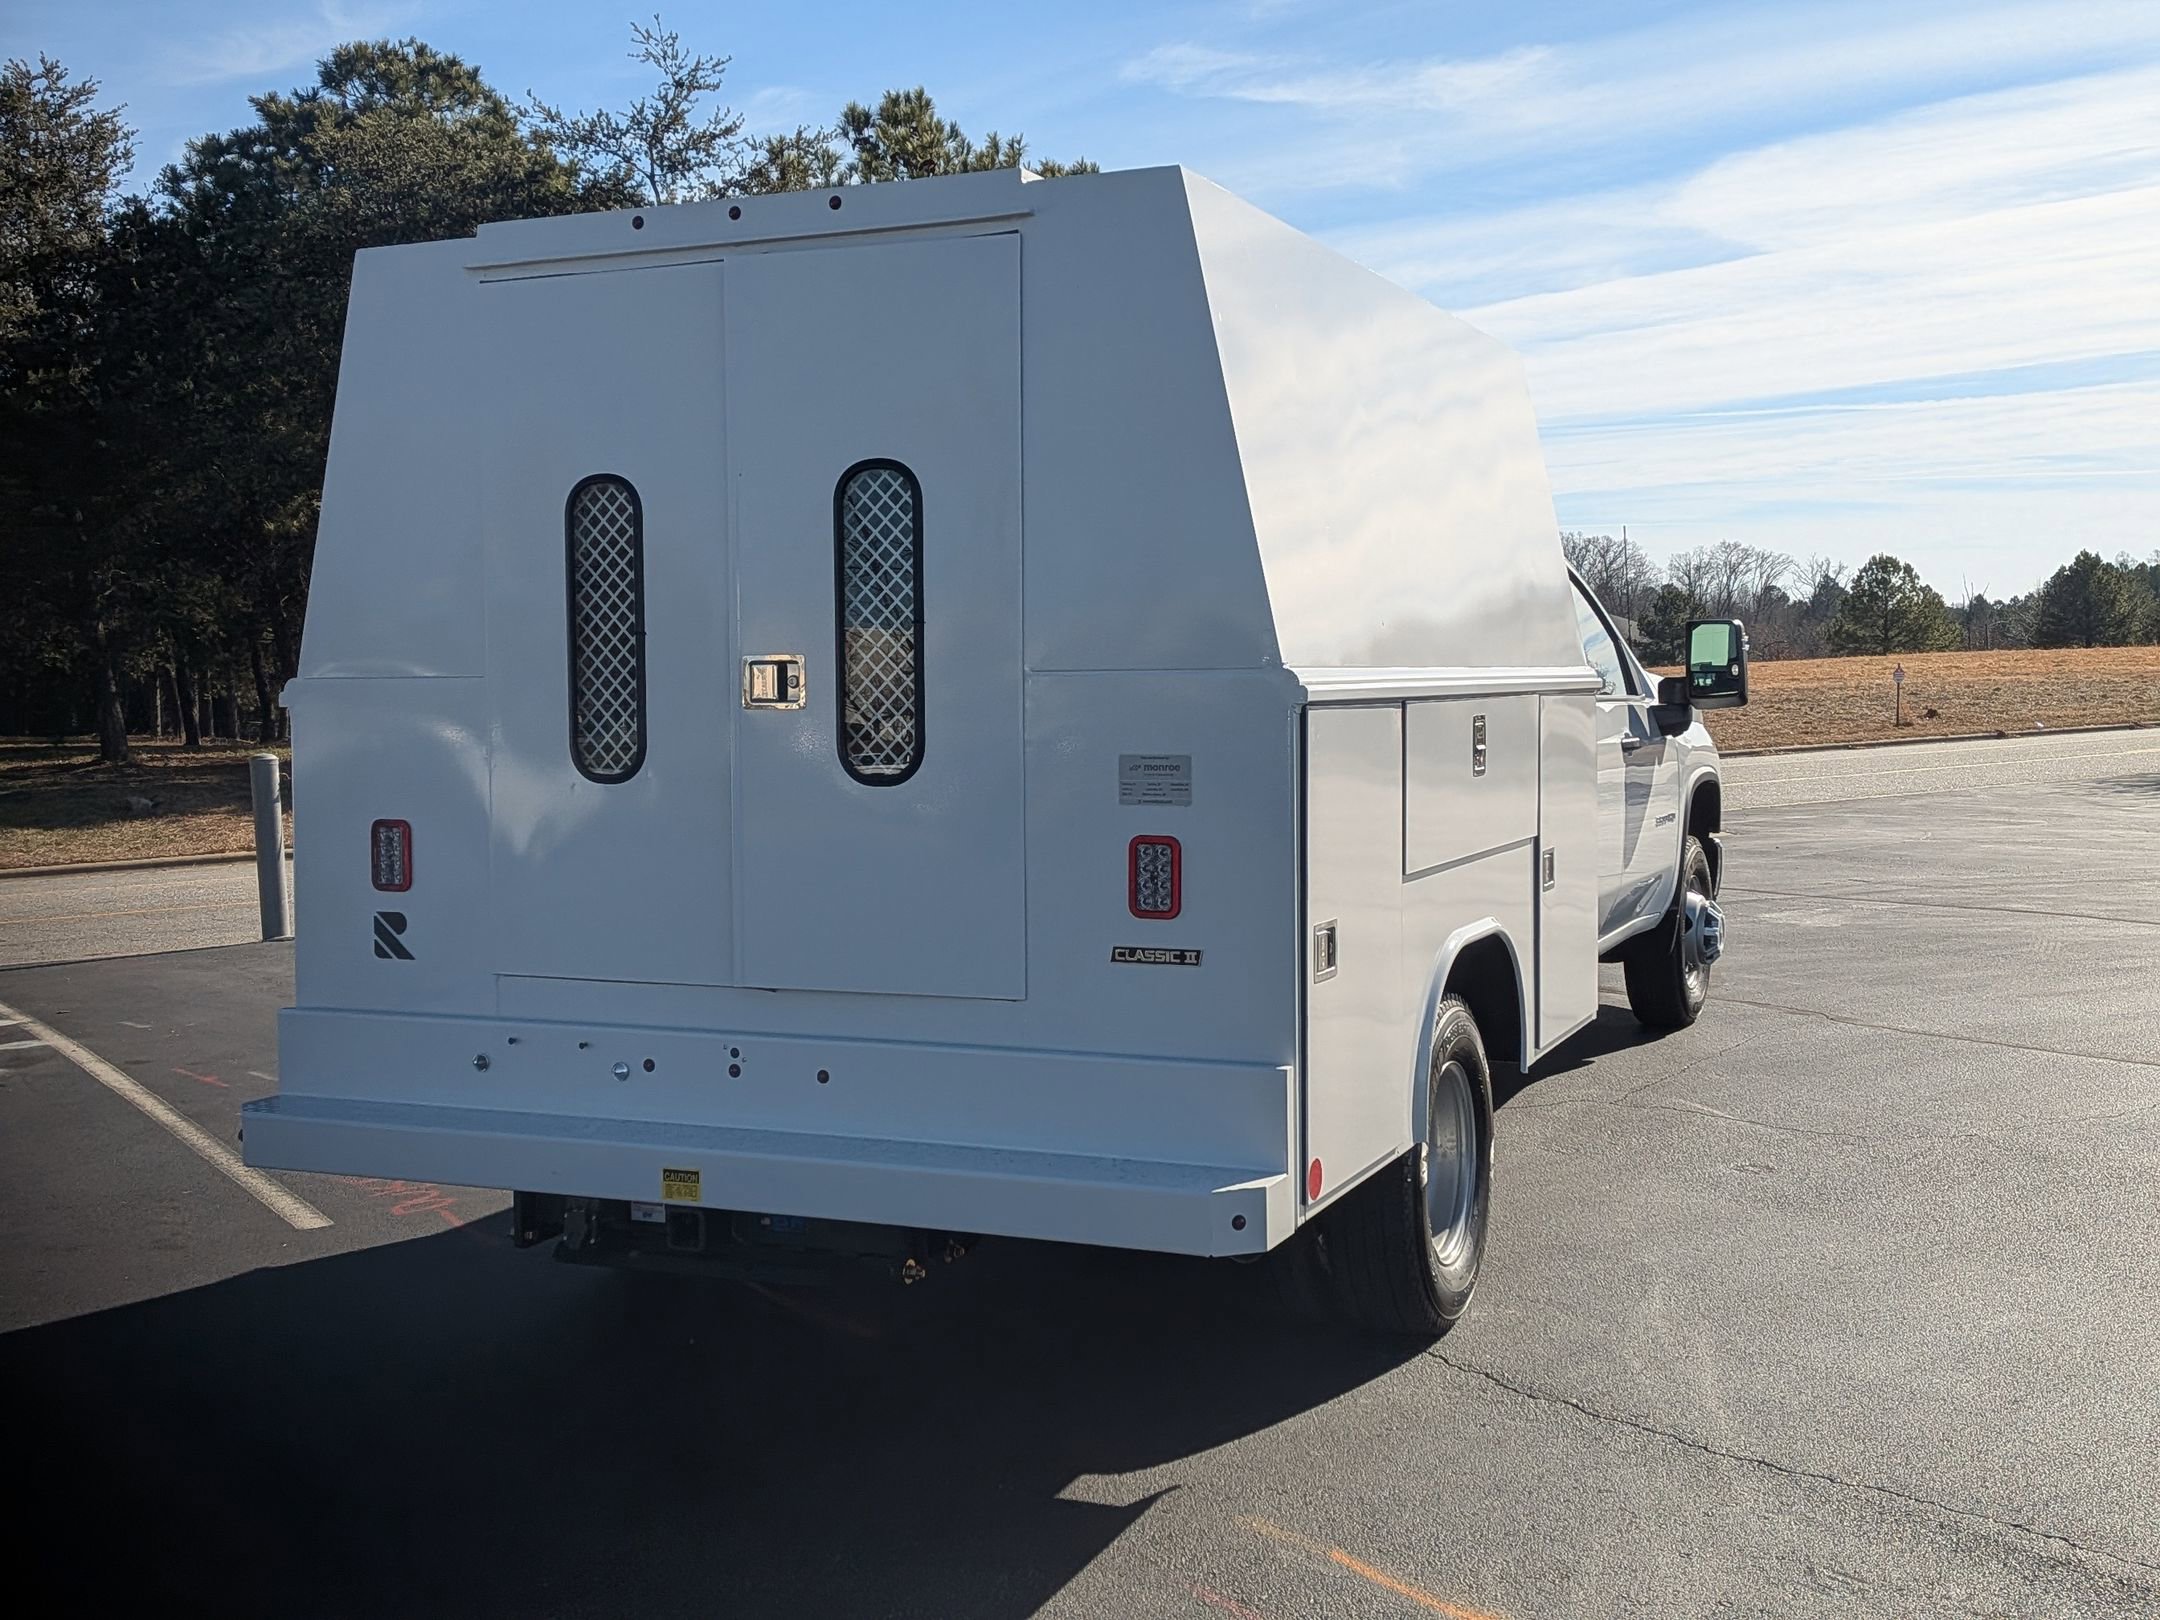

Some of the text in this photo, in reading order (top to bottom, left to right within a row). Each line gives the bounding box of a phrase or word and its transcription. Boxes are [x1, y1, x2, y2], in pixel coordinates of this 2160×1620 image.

[1144, 764, 1181, 772] monroe
[1114, 948, 1198, 964] CLASSIC II
[664, 1171, 698, 1183] CAUTION
